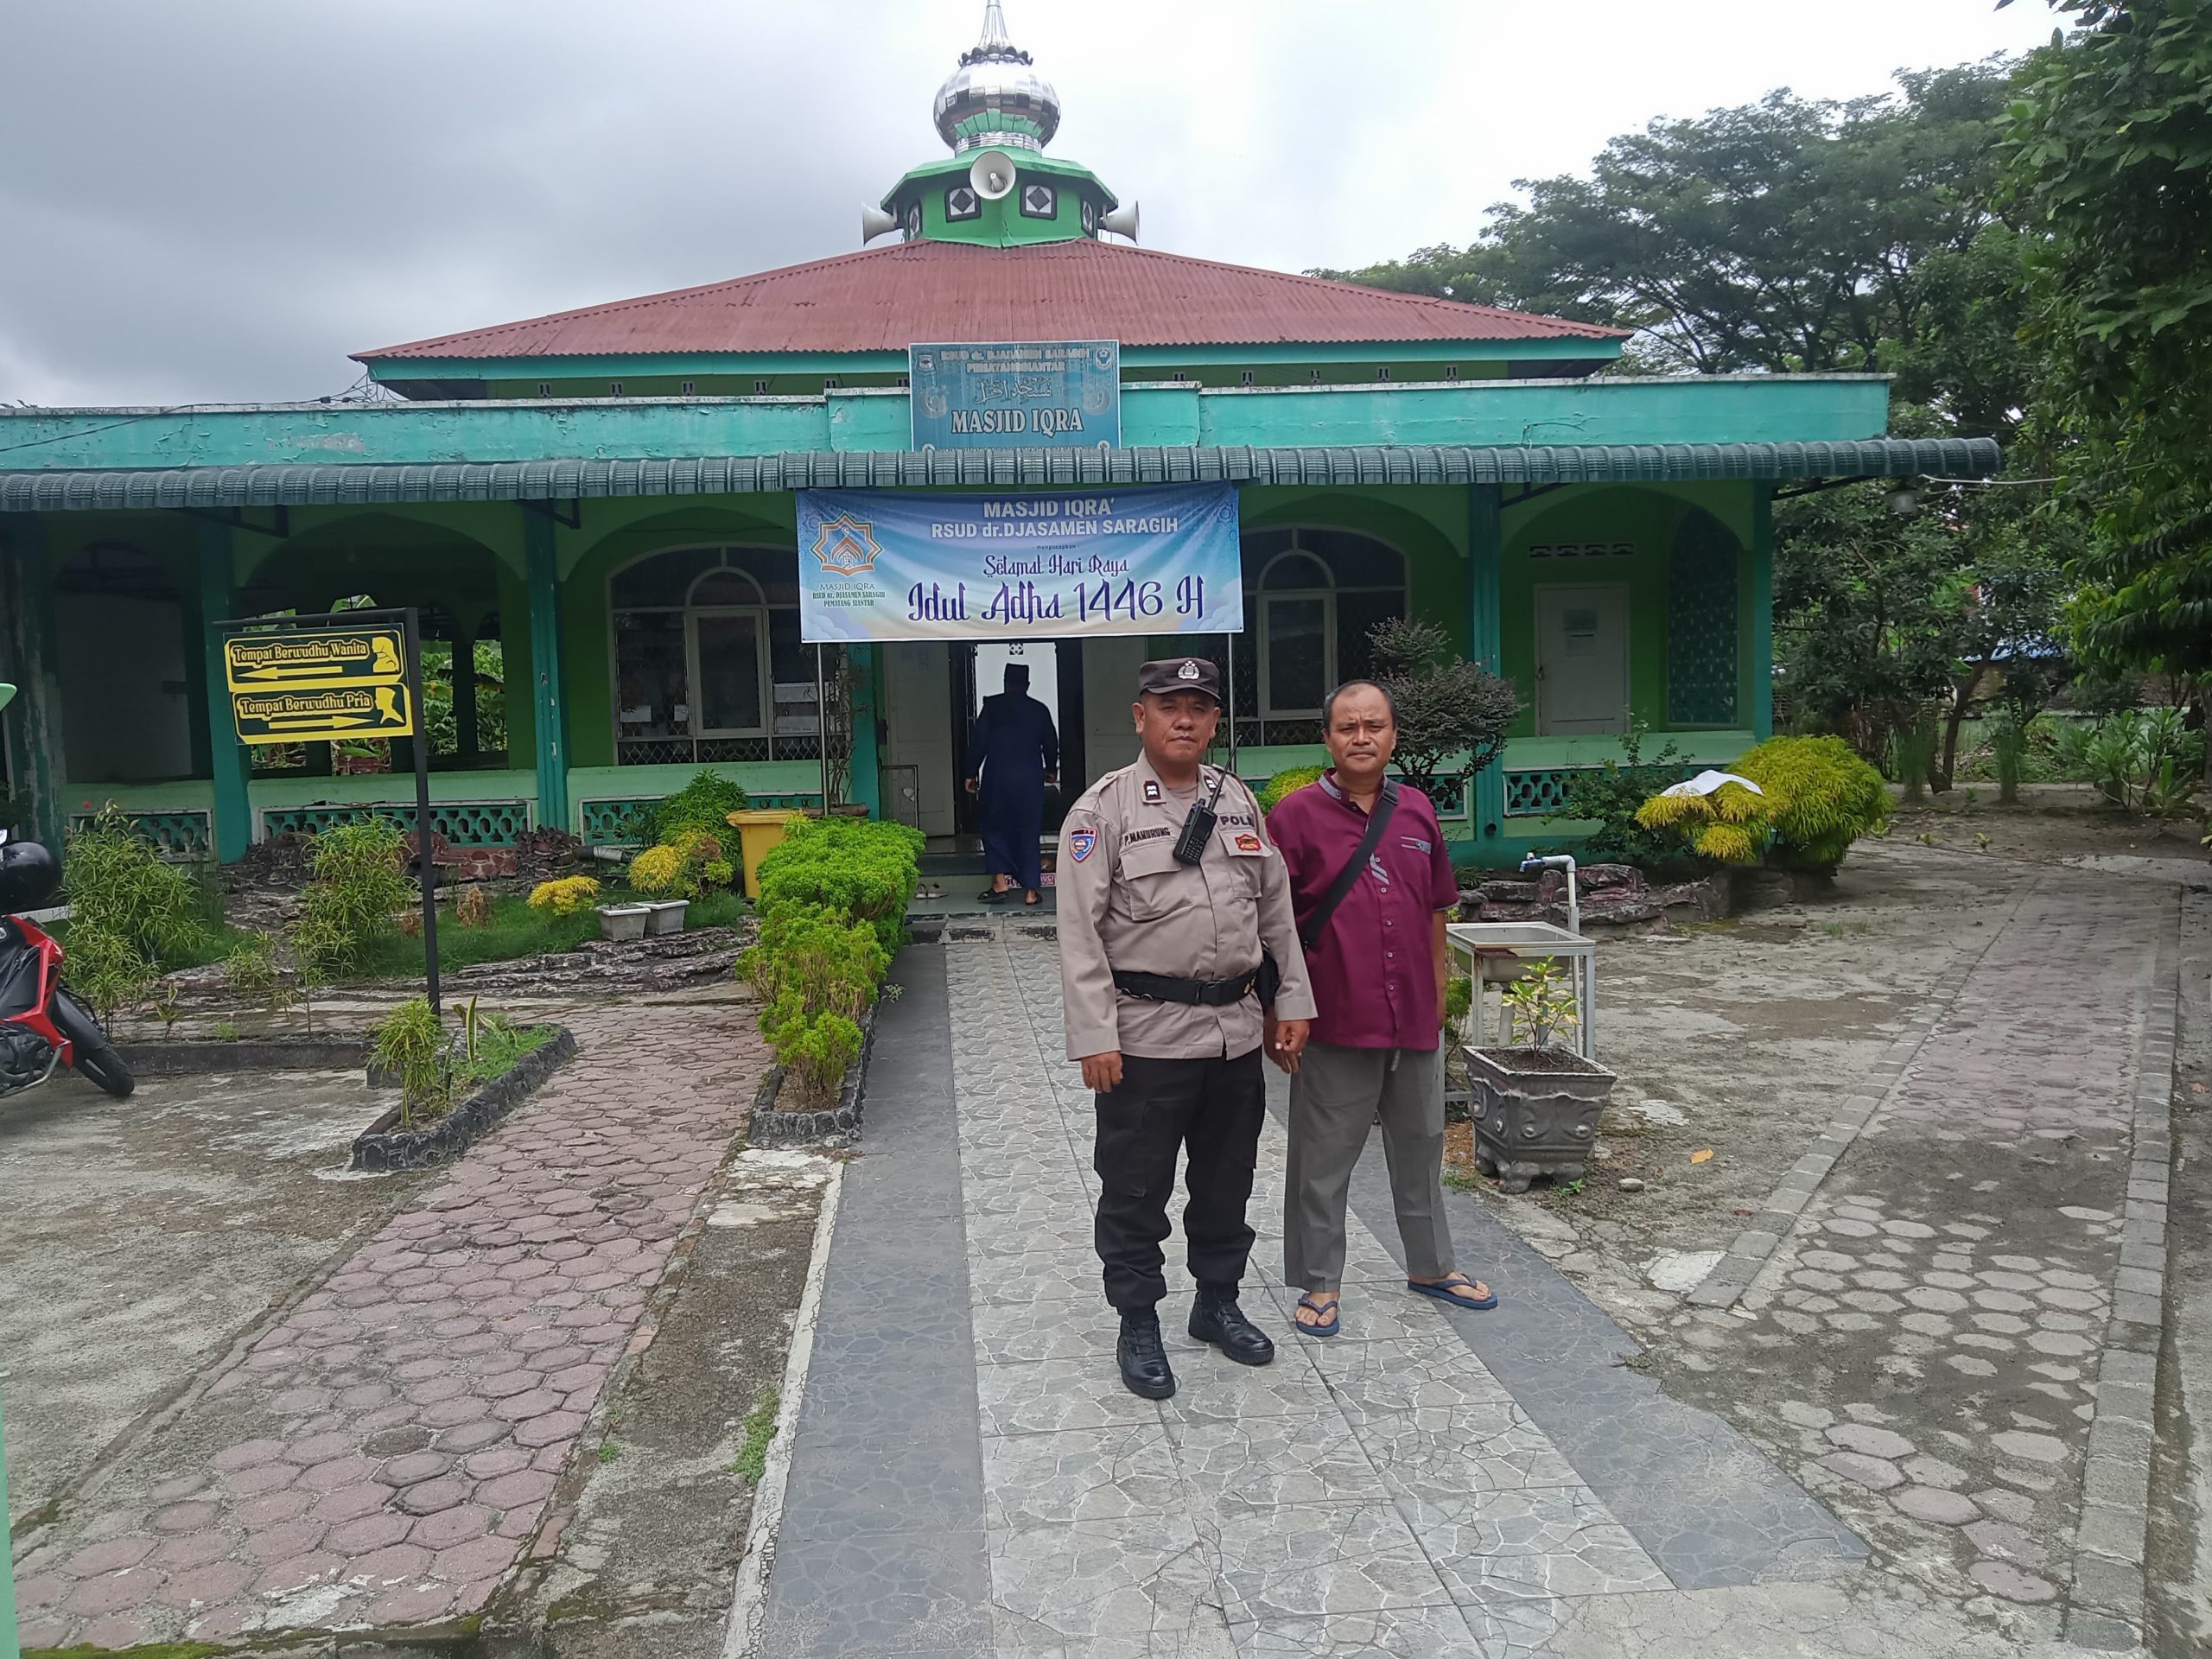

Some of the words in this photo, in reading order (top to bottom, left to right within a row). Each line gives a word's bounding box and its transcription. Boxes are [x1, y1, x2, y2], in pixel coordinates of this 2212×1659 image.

[951, 410, 1026, 433] MASJID
[1032, 408, 1084, 437] IQRA
[983, 499, 1058, 518] MASJID
[931, 524, 977, 537] RSUD
[982, 520, 1097, 537] dr.DJASAMEN
[1102, 517, 1179, 534] SARAGIH
[983, 555, 1044, 578] Selamat
[1048, 554, 1084, 575] Hari
[1088, 554, 1130, 577] Raya
[907, 582, 969, 621] Idul
[981, 579, 1065, 626] Adha
[1073, 577, 1164, 623] 1446
[1176, 575, 1205, 620] H
[234, 645, 273, 665] Tempat
[275, 640, 329, 660] Berwudhu
[331, 640, 366, 656] Wanita
[240, 697, 284, 717] Tempat
[285, 693, 344, 711] Berwudhu
[346, 691, 372, 708] Pria
